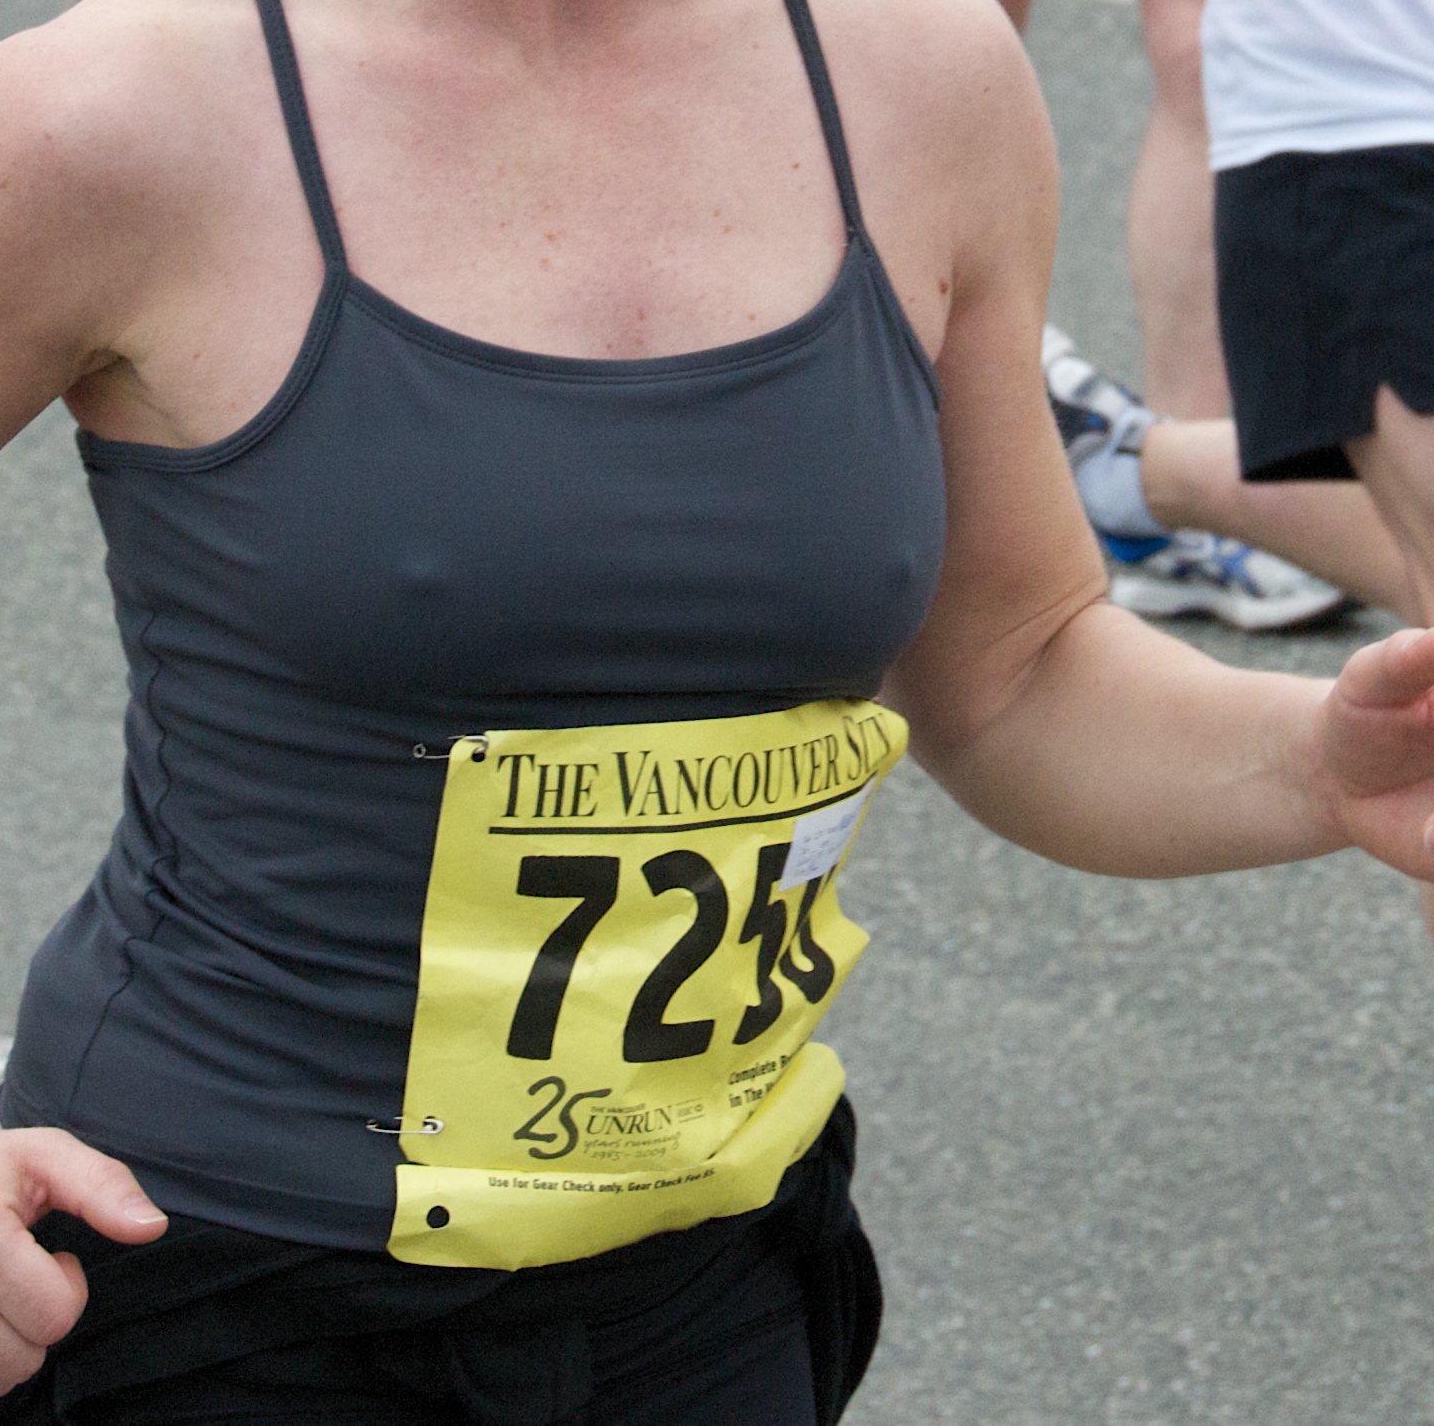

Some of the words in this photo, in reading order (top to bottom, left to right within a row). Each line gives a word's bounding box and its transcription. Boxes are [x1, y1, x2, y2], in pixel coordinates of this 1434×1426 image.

[496, 752, 600, 819] THE
[613, 733, 841, 818] VANCOUVER
[842, 711, 894, 783] SUN
[728, 1060, 777, 1085] Complete
[744, 1087, 763, 1103] The
[513, 1075, 613, 1160] 25
[488, 1177, 510, 1189] Use
[512, 1177, 529, 1189] for
[532, 1178, 558, 1191] Gear
[562, 1179, 596, 1193] Check
[598, 1181, 624, 1195] only.
[627, 1181, 652, 1192] Gear
[654, 1176, 683, 1190] Check
[684, 1173, 702, 1183] Fee
